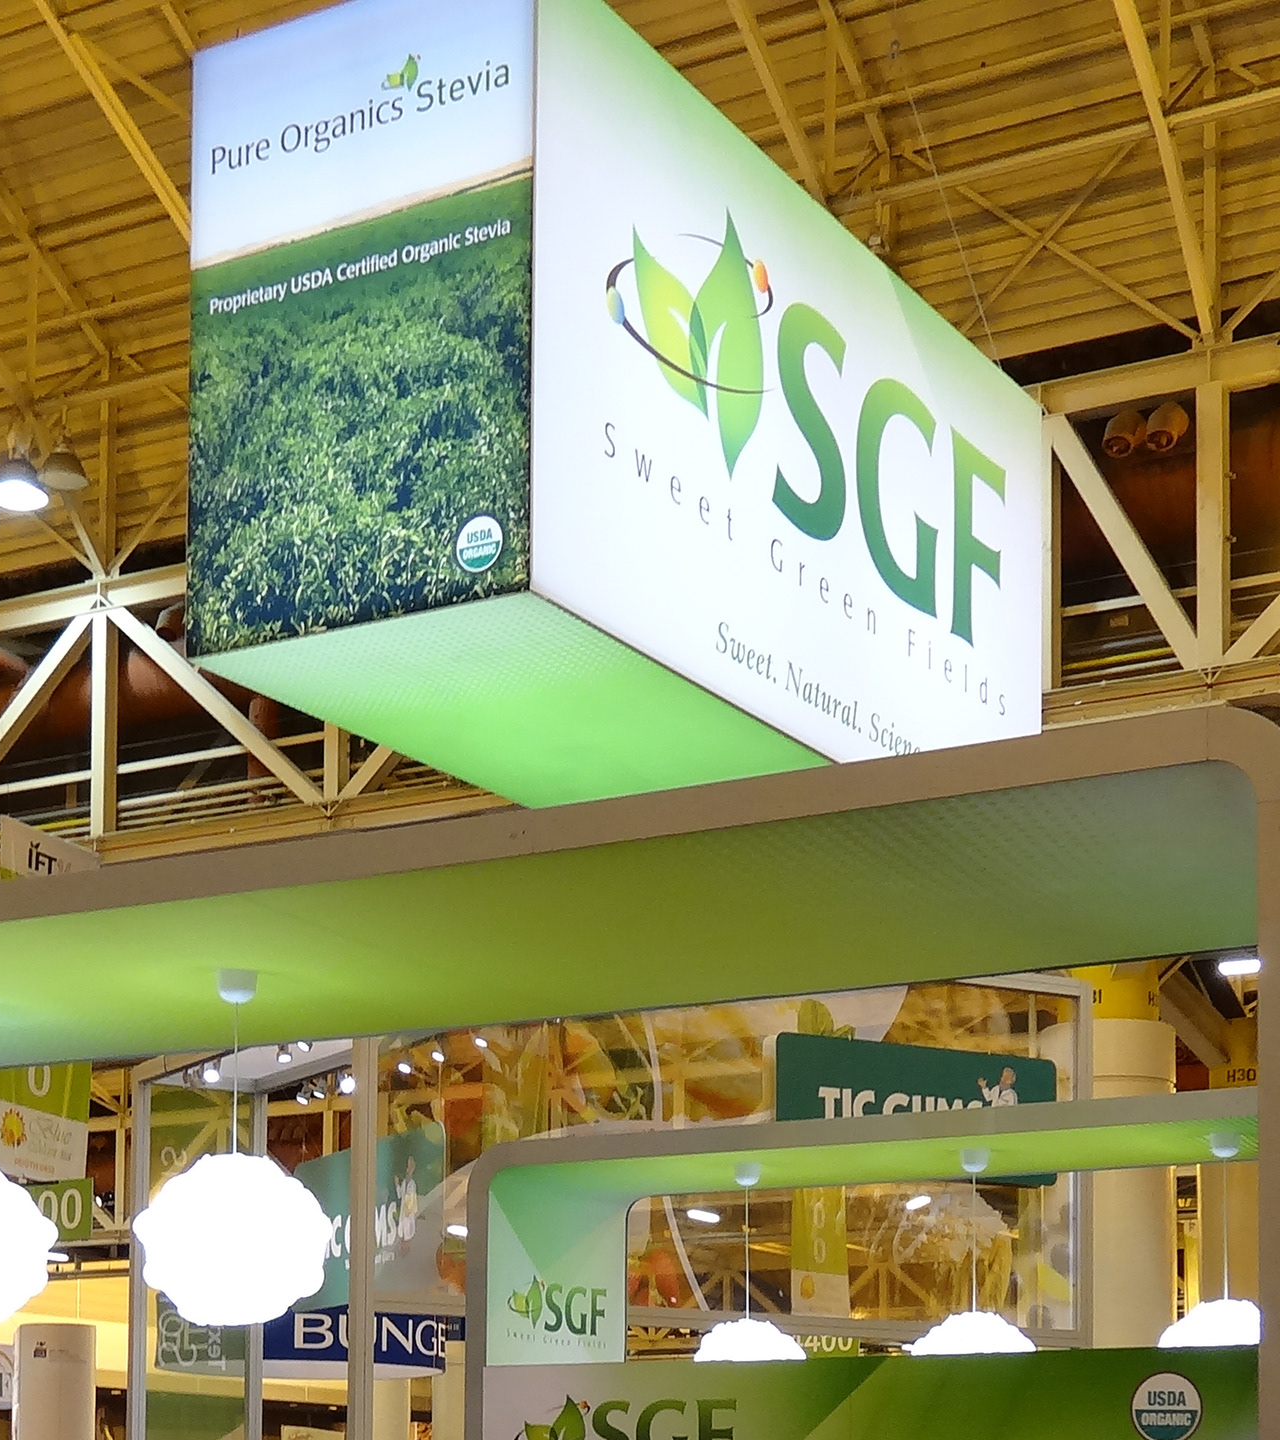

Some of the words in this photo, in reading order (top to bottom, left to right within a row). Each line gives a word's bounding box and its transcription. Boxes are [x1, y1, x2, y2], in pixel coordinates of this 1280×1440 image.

[210, 137, 271, 175] Pure
[280, 96, 404, 153] Organics
[415, 60, 511, 113] Stevia
[209, 281, 288, 316] Proprietary
[290, 267, 334, 295] USDA
[336, 248, 398, 281] Certified
[401, 231, 462, 264] Organic
[464, 218, 512, 246] Stevia
[772, 300, 1007, 649] SGF
[462, 543, 497, 561] ORGANIC
[466, 528, 493, 545] USDA
[603, 420, 734, 543] Sweet
[770, 537, 878, 636] Green
[907, 627, 1008, 717] Fields
[715, 619, 778, 685] Sweet.
[785, 659, 863, 735] Natural.
[544, 1282, 608, 1337] SGF
[1140, 1411, 1192, 1427] ORGANIC
[1147, 1390, 1187, 1407] USDA
